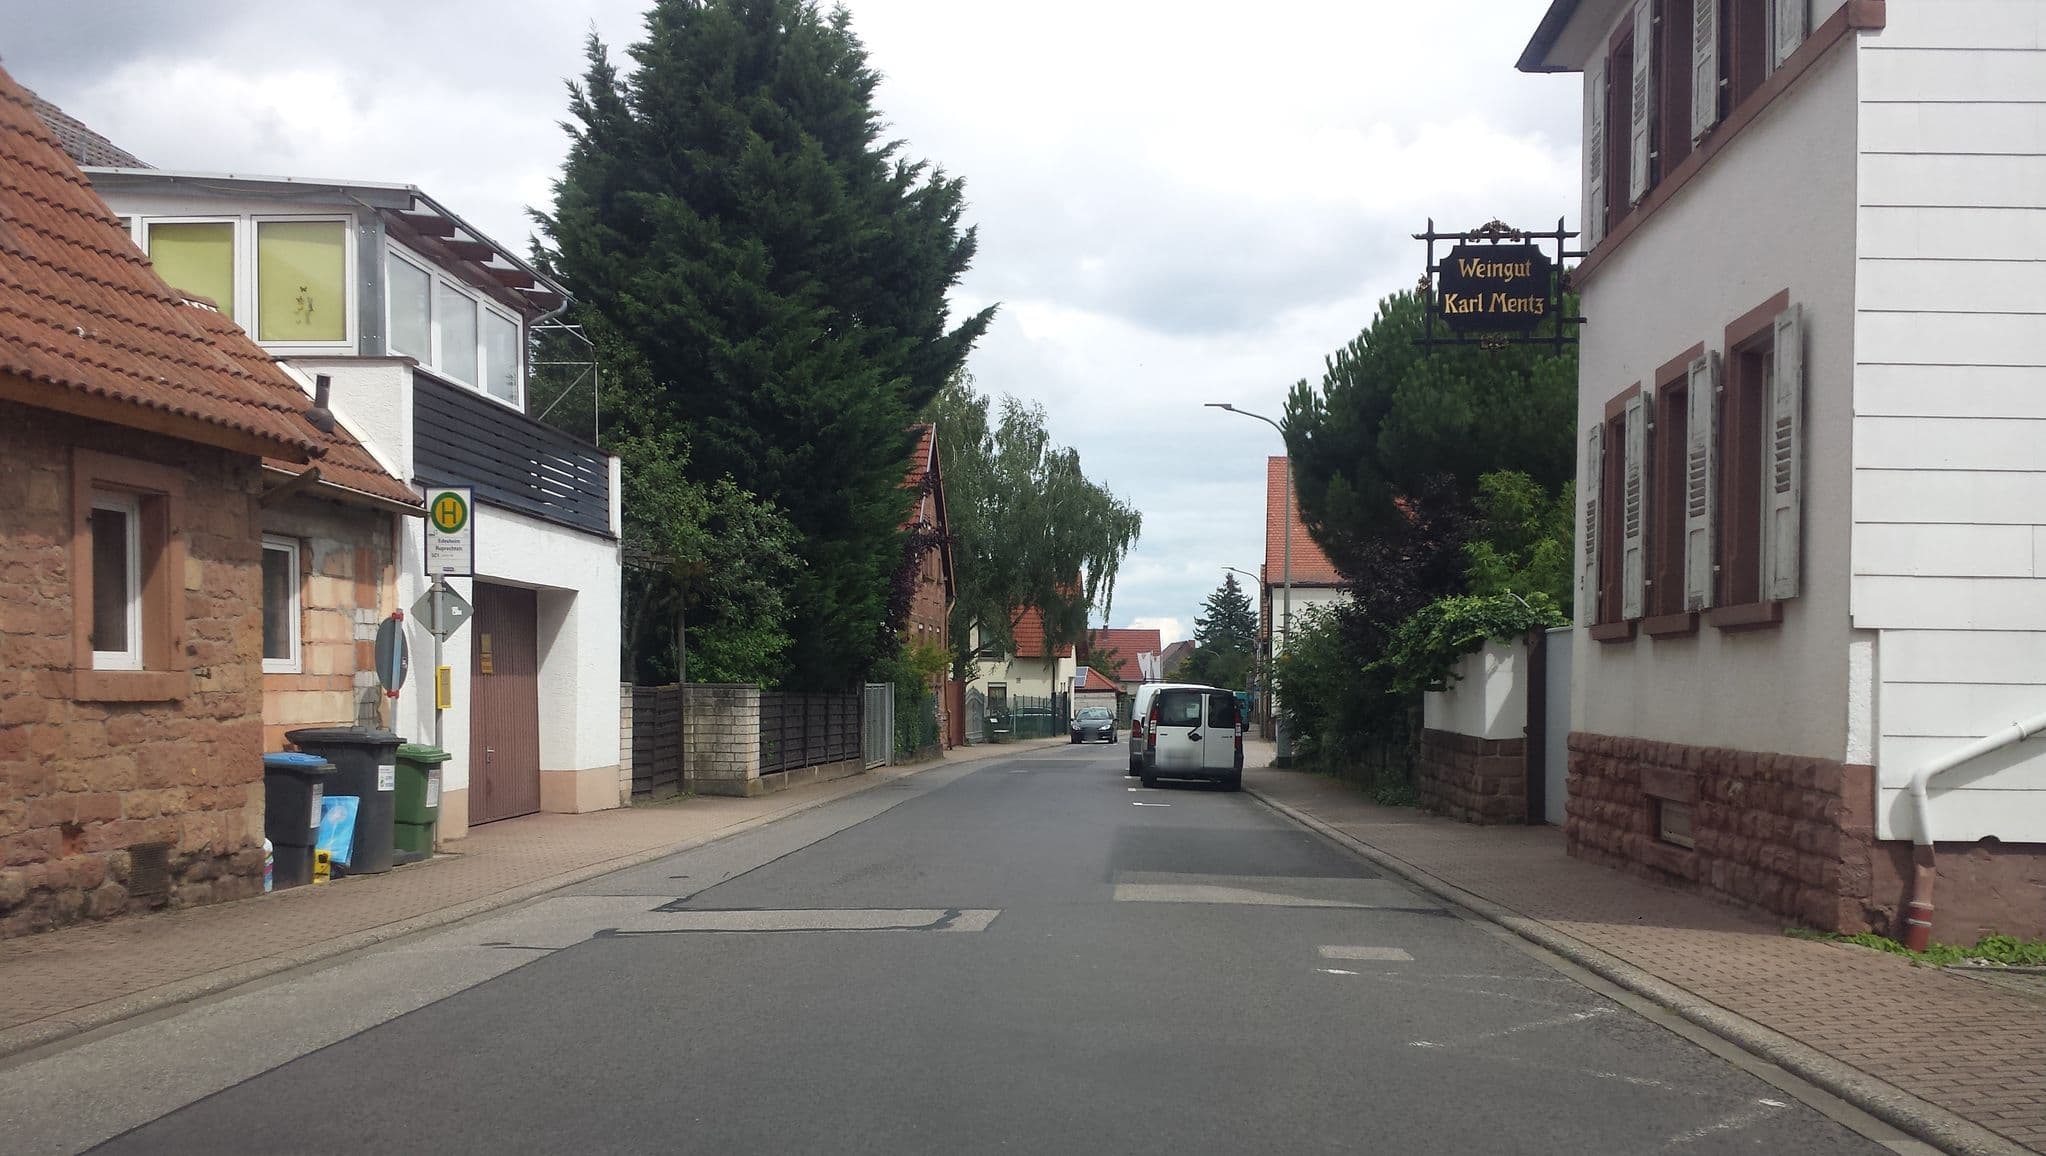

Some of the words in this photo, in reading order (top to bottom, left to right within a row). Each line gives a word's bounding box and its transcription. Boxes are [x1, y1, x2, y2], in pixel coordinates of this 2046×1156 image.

[1458, 258, 1532, 283] Weingut
[1444, 292, 1483, 314] Karl
[1488, 292, 1545, 315] Mentz
[441, 501, 457, 524] H
